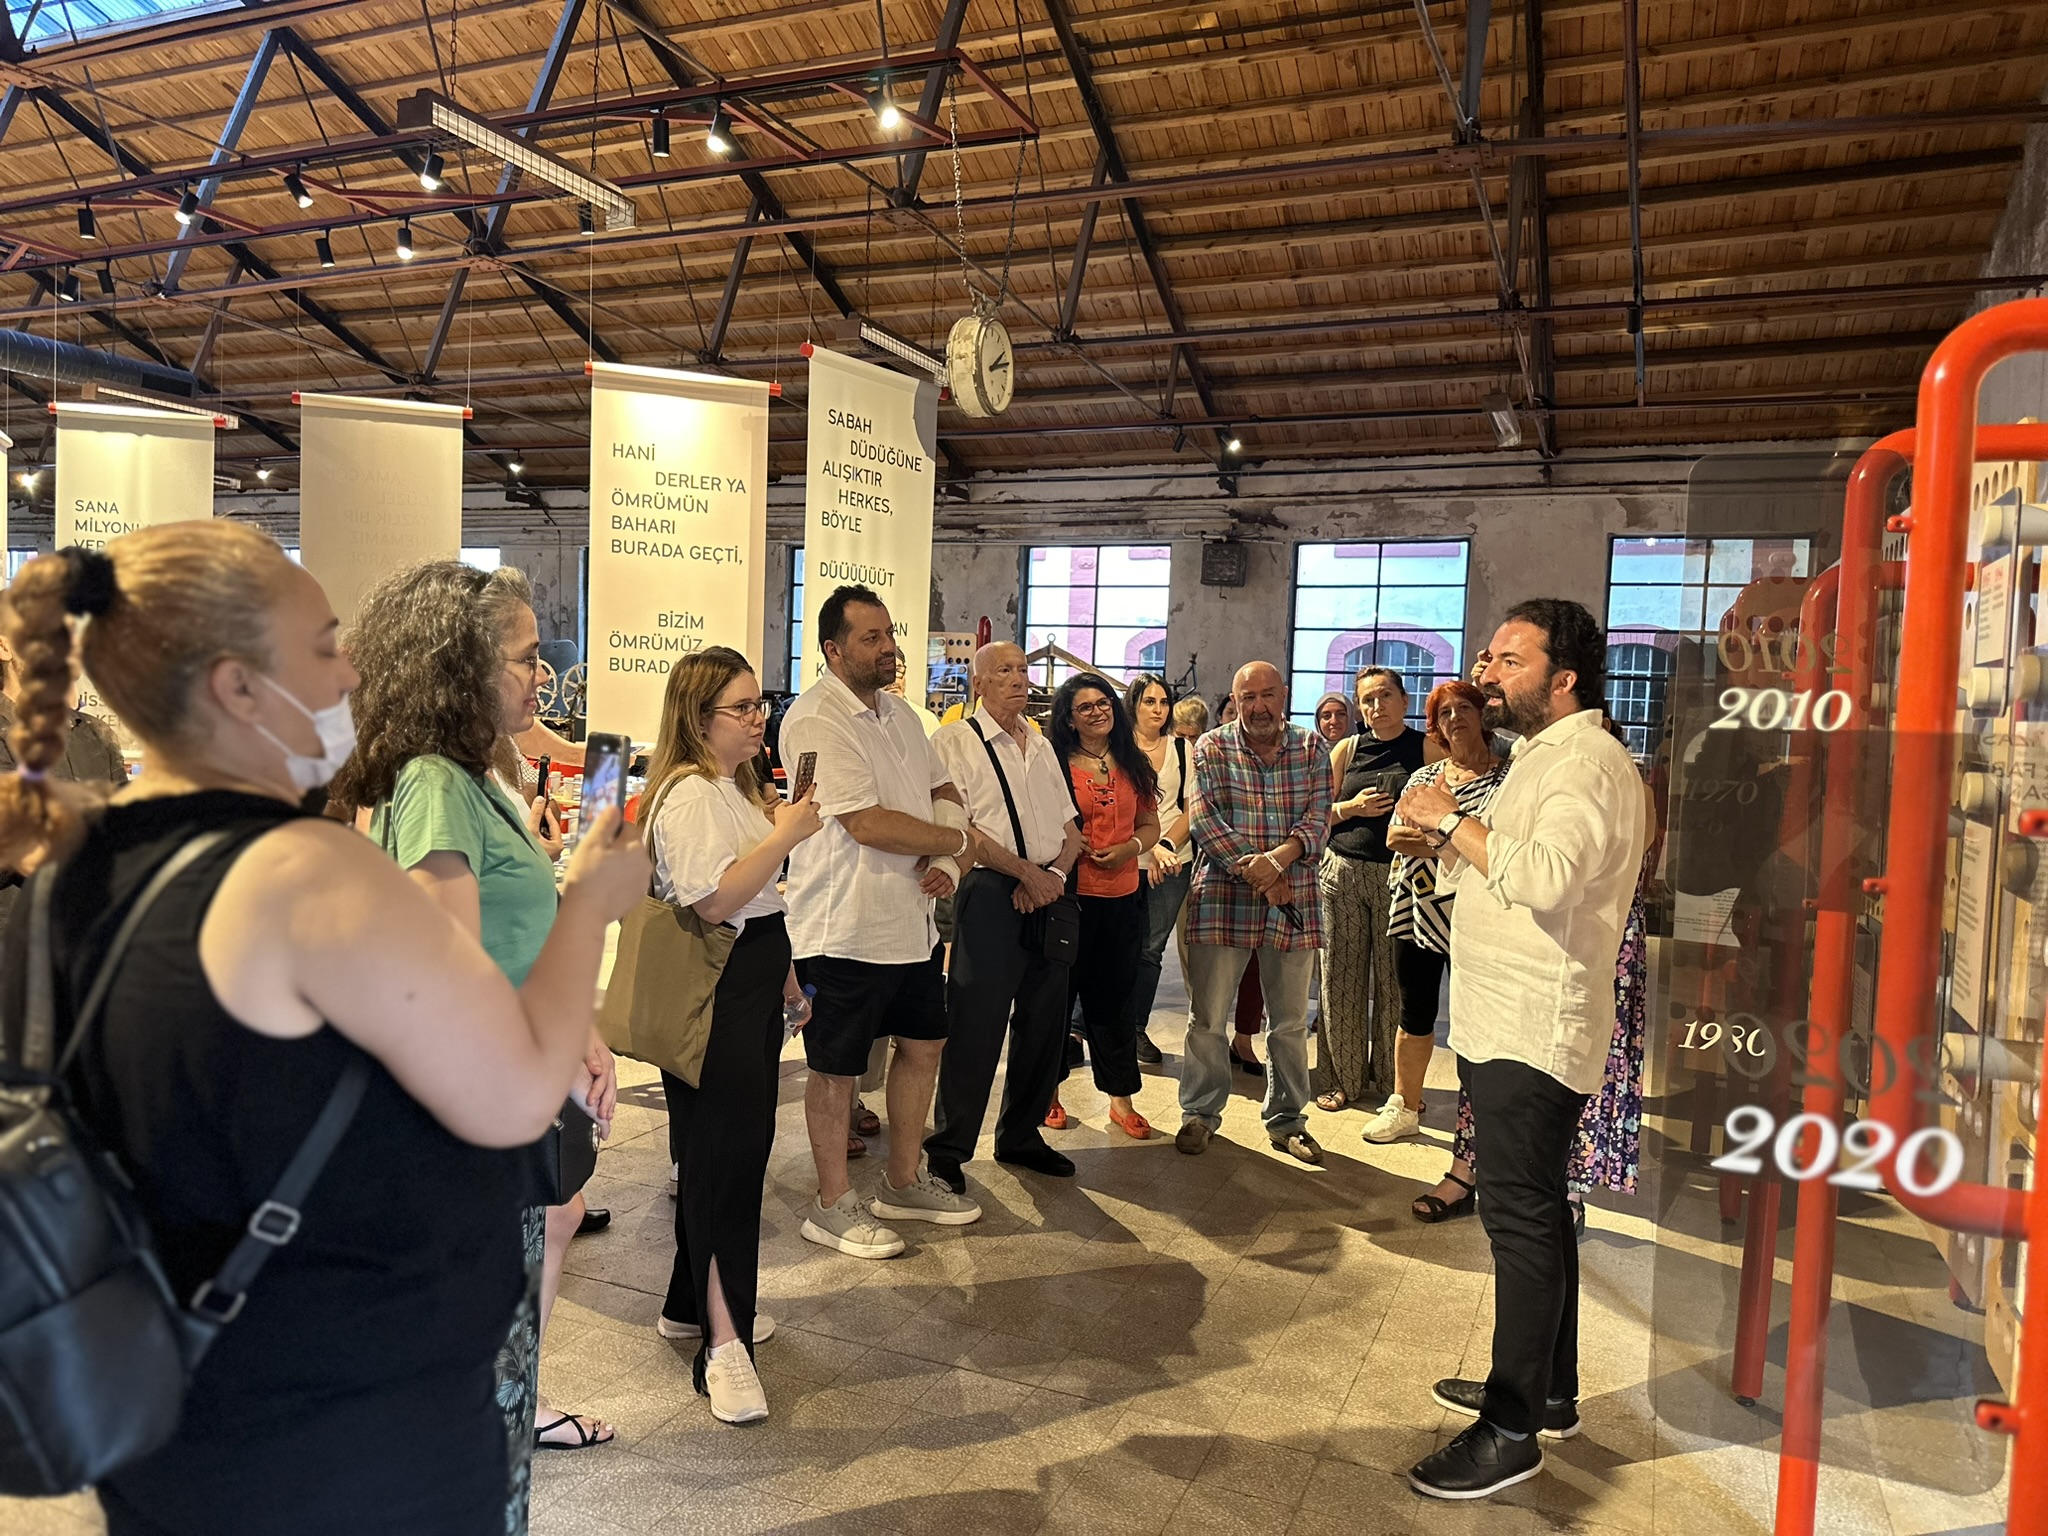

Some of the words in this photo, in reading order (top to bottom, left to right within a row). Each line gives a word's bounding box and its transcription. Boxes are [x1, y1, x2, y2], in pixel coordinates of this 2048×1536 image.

[828, 408, 872, 435] SABAH
[612, 442, 655, 461] HANİ
[850, 439, 922, 472] DÜDÜĞÜNE
[655, 471, 722, 492] DERLER
[726, 477, 747, 494] YA
[822, 460, 883, 487] ALIŞIKTIR
[75, 499, 119, 514] SANA
[611, 488, 708, 514] ÖMRÜMÜN
[838, 489, 893, 516] HERKES,
[75, 517, 151, 534] MİLYON
[611, 515, 676, 534] BAHARI
[821, 509, 862, 533] BÖYLE
[611, 539, 685, 559] BURADA
[689, 545, 743, 565] GEÇTİ,
[820, 560, 895, 587] DÜÜÜÜÜÜT
[658, 610, 704, 630] BİZİM
[609, 630, 703, 652] ÖMRÜMÜZ
[609, 657, 671, 674] BURAD
[1708, 687, 1853, 732] 2010
[1709, 1104, 1966, 1198] 2020
